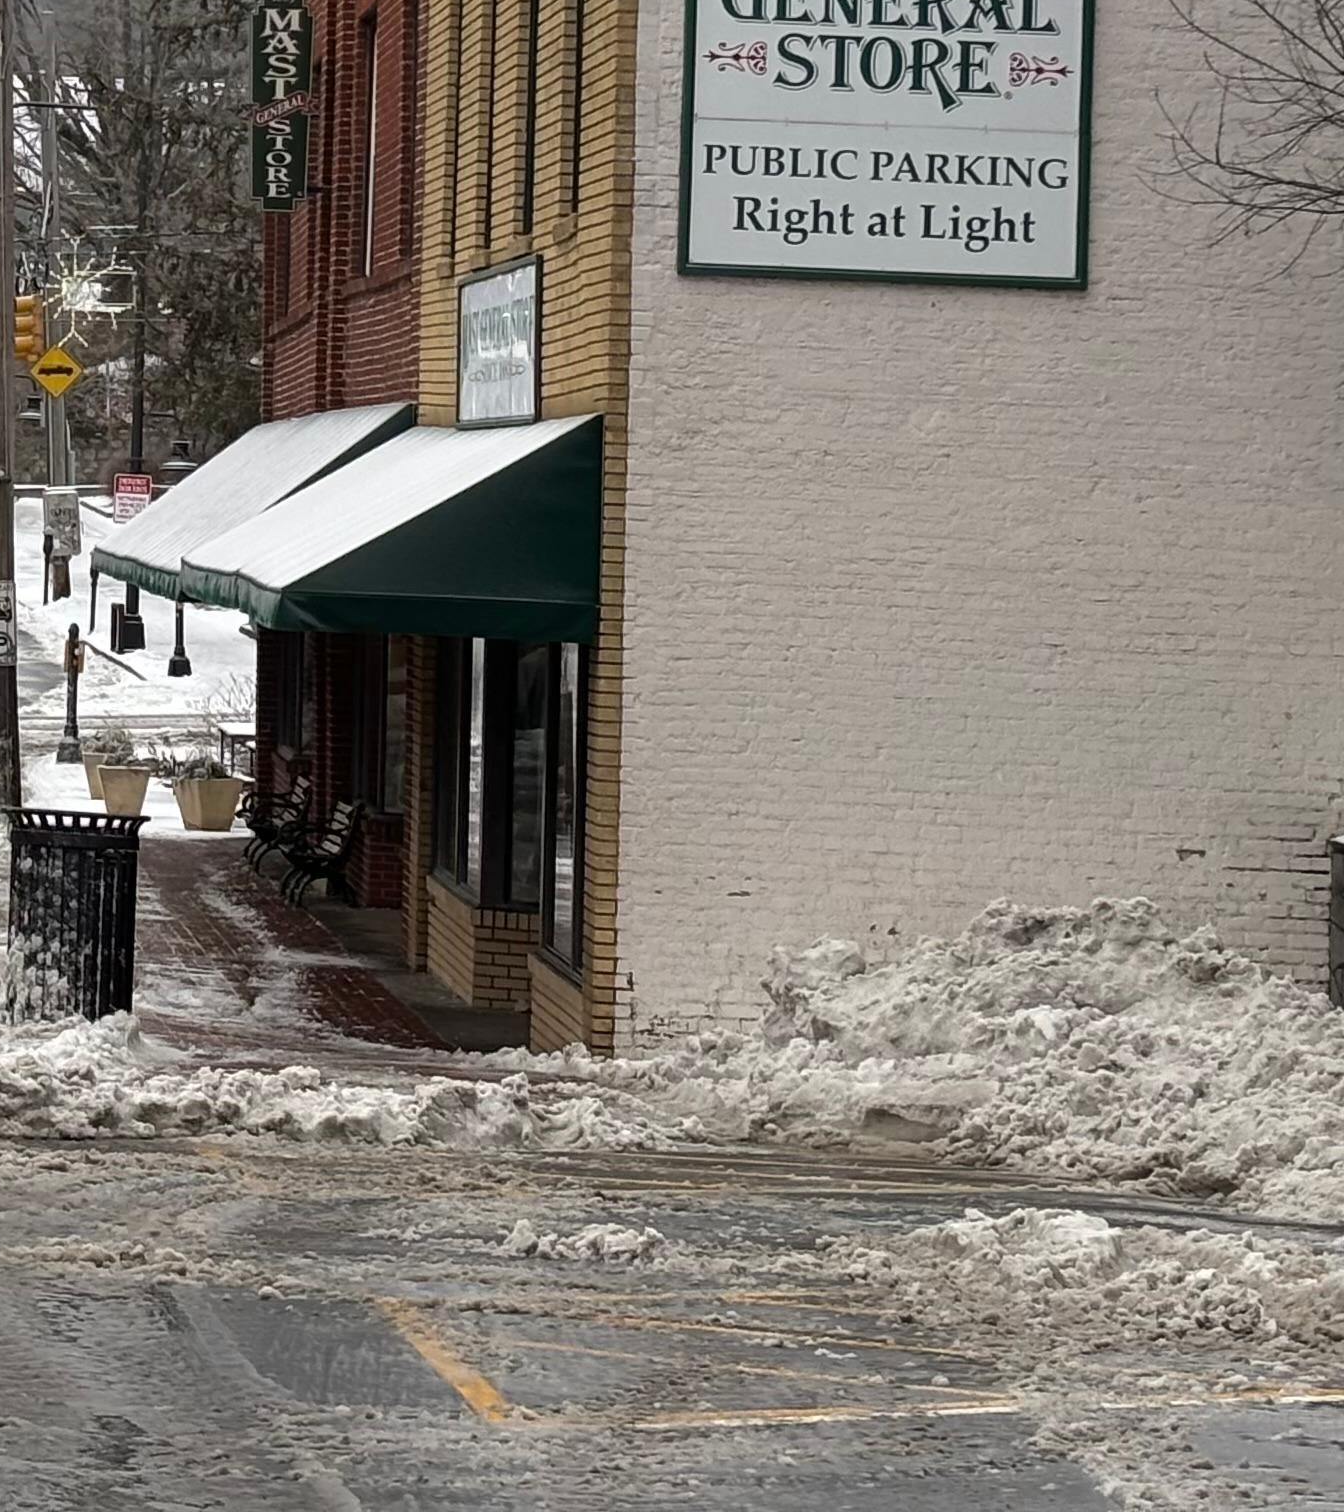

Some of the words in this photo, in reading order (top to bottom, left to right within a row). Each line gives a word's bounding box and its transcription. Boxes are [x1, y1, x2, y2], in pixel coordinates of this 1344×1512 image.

[260, 8, 303, 100] MAST
[773, 33, 1004, 113] STORE
[256, 93, 305, 124] GENERAL
[265, 119, 293, 198] STORE
[702, 144, 859, 181] PUBLIC
[870, 151, 1069, 189] PARKING
[732, 196, 855, 245] Right
[867, 206, 906, 238] at
[920, 204, 1036, 253] Light
